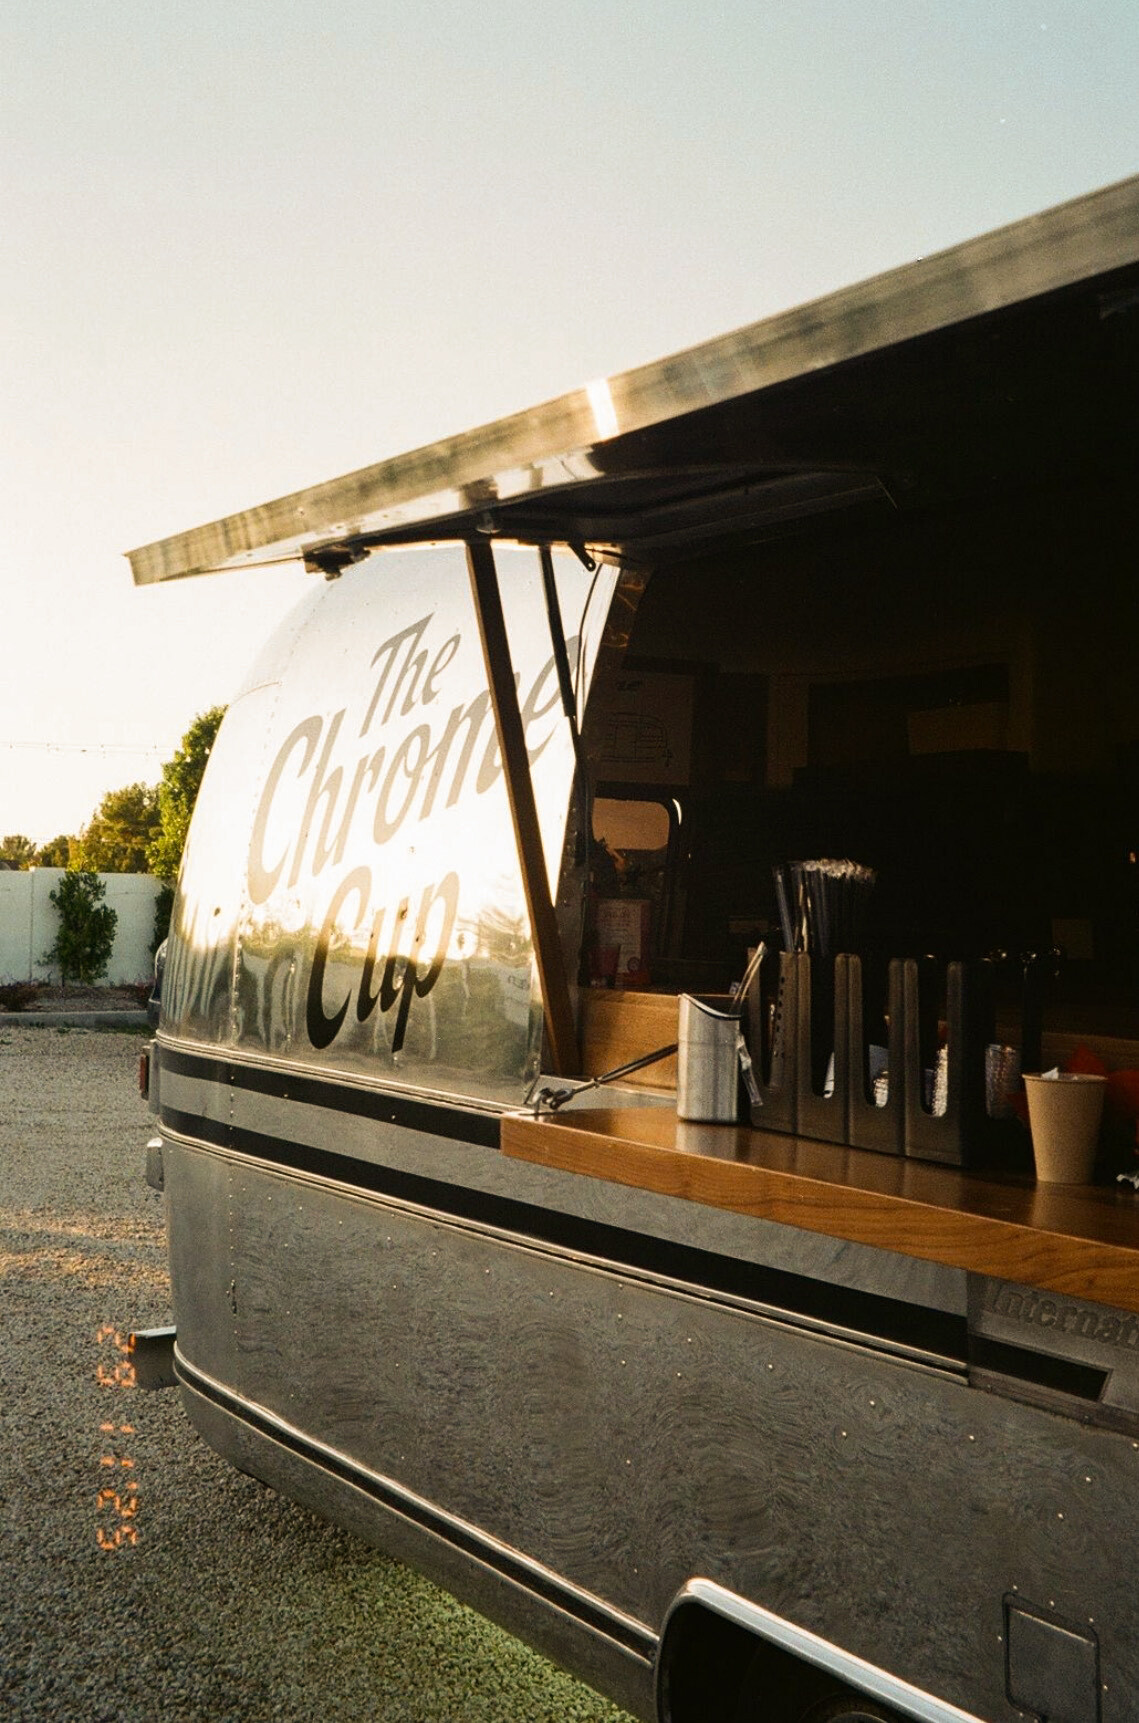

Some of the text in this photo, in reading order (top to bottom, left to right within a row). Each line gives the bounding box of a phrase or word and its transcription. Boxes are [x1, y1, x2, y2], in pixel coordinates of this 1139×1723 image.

[247, 634, 582, 905] Chrome
[359, 612, 462, 739] The
[306, 864, 460, 1053] Cup
